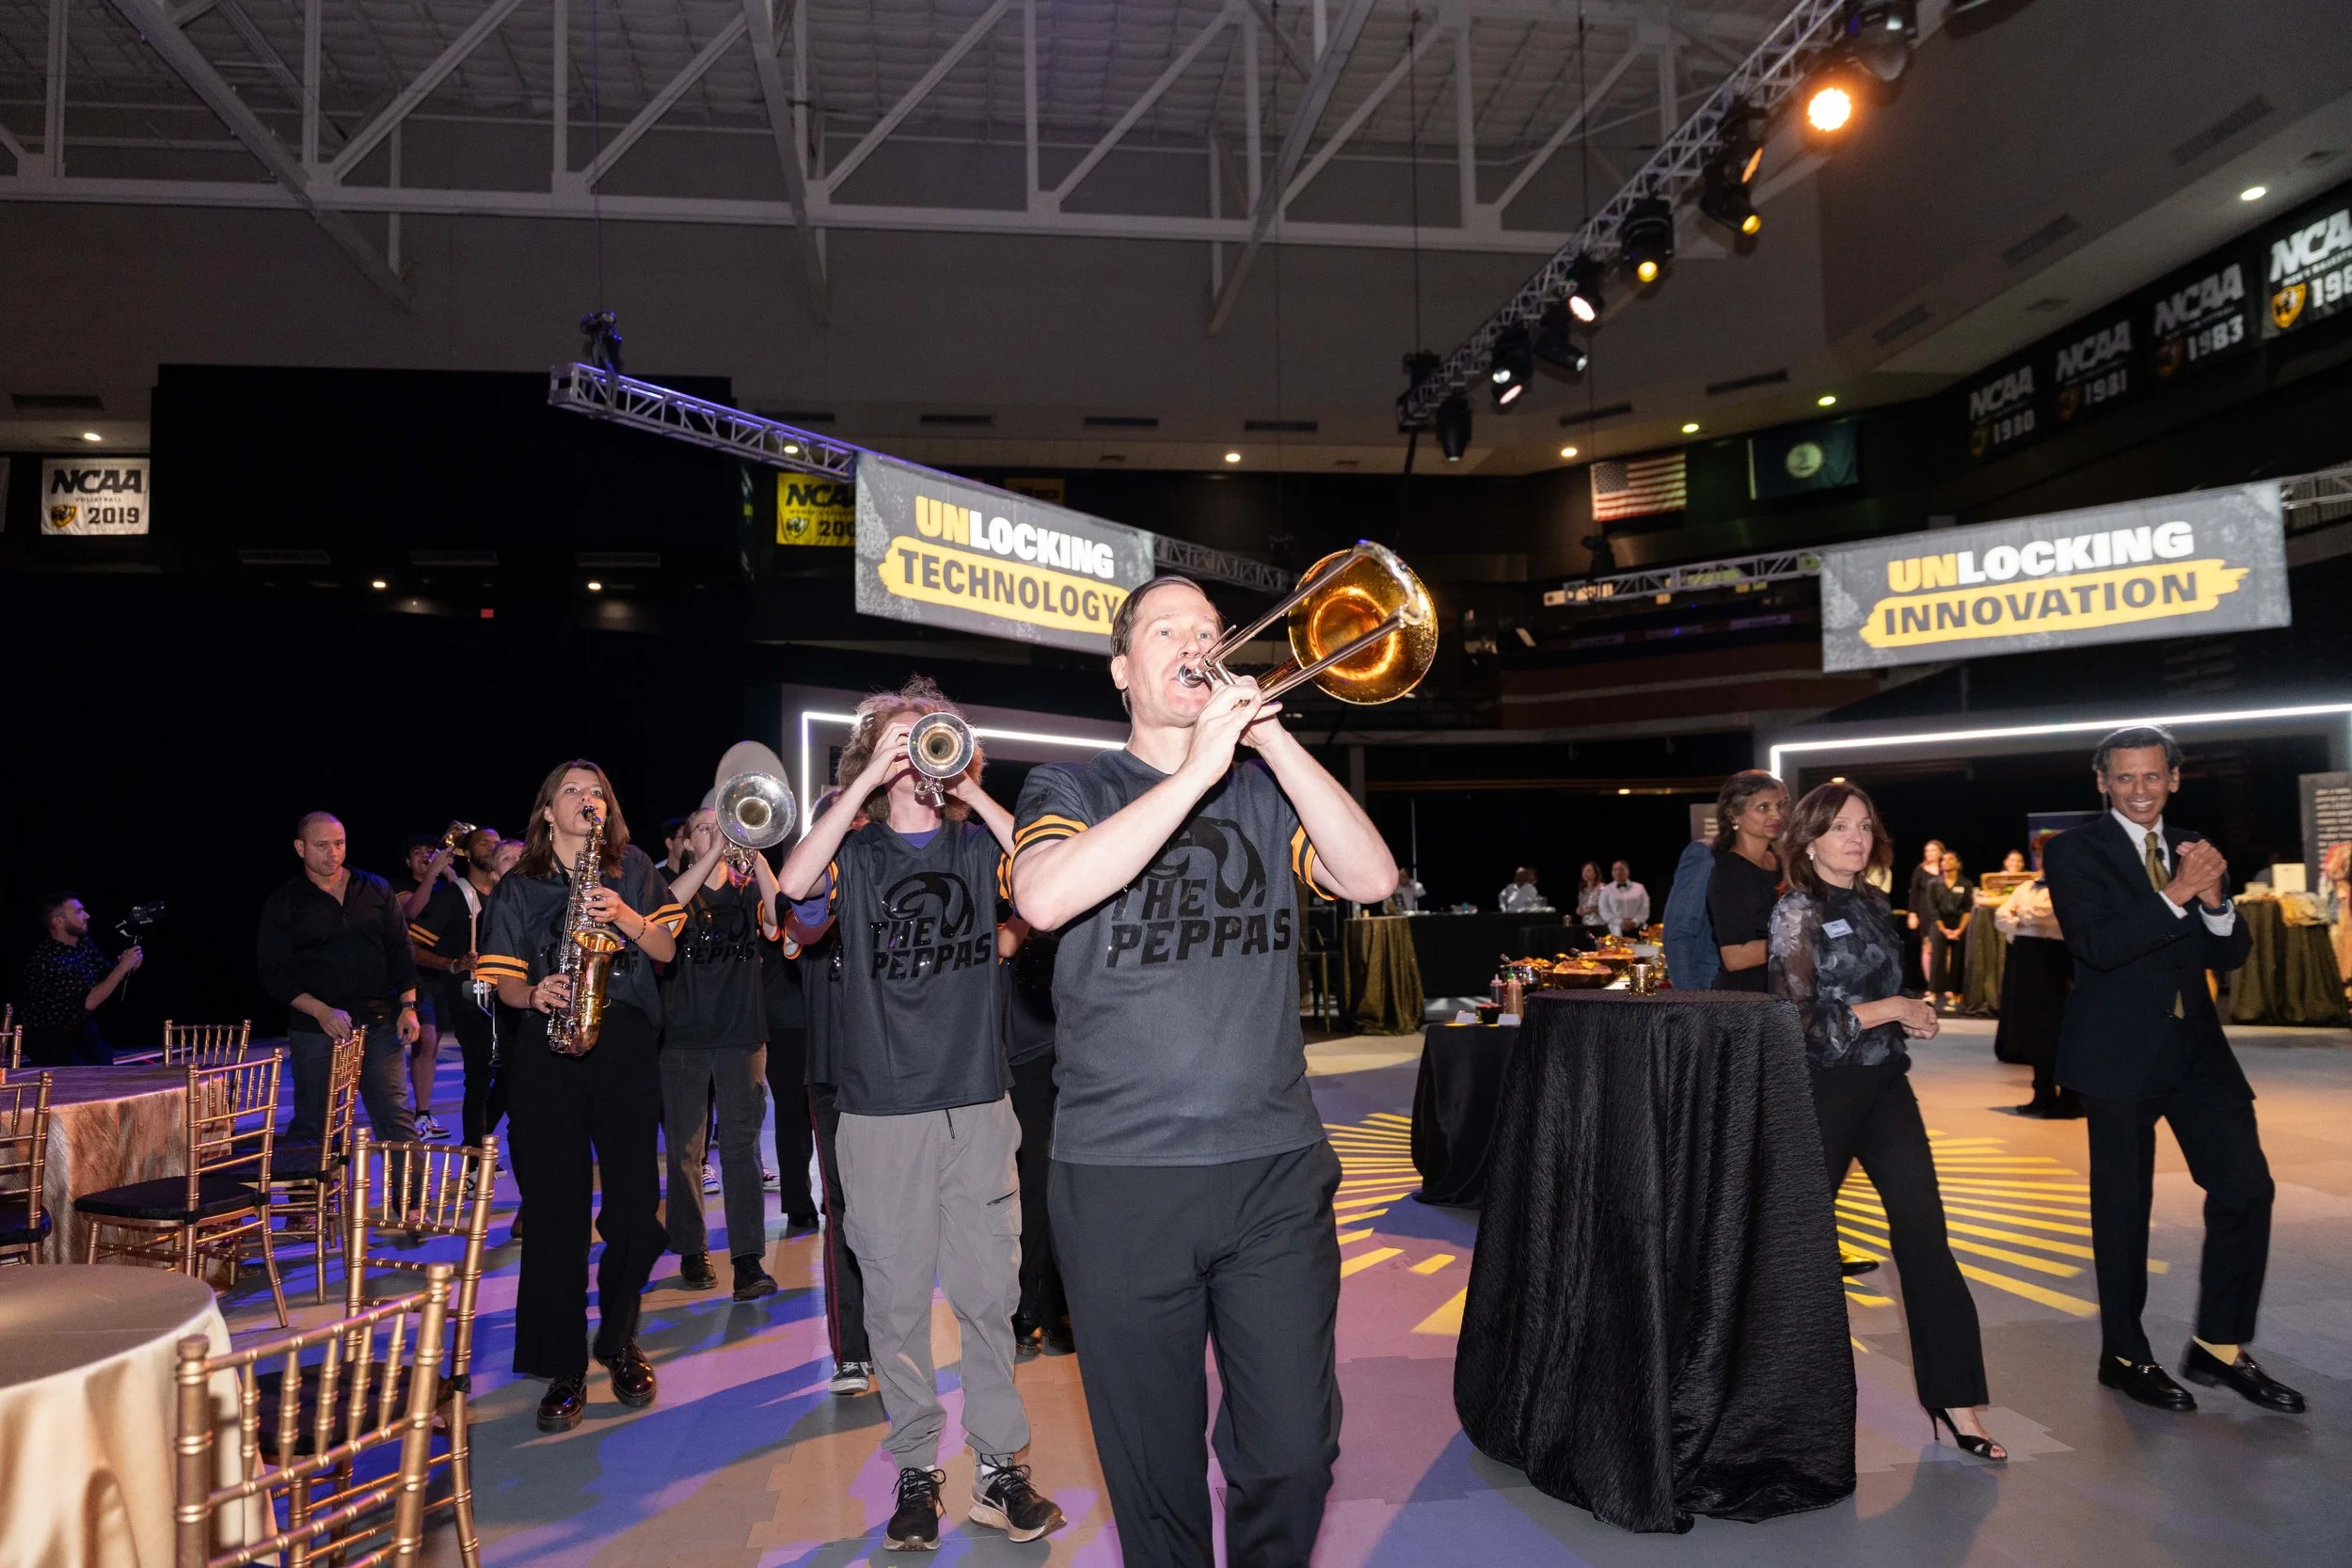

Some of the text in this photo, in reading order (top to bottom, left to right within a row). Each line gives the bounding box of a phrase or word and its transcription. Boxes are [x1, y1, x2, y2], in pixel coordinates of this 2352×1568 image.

[2269, 209, 2352, 282] NCA
[2154, 262, 2245, 337] NCAA
[2311, 263, 2352, 309] 198
[2056, 320, 2133, 382] NCAA
[2188, 314, 2244, 362] 1983
[1970, 364, 2034, 421] NCAA
[2085, 368, 2127, 406] 1981
[51, 469, 142, 494] NCAA
[786, 483, 856, 507] NCA
[88, 507, 140, 524] 2019
[819, 520, 856, 537] 200
[915, 495, 1115, 579] UNLOCKING
[1887, 520, 2195, 594] UNLOCKING
[898, 547, 1120, 625] TECHNOLOGY
[1884, 571, 2198, 637] INNOVATION
[869, 916, 936, 950] THE
[870, 933, 993, 981] PEPPAS
[1105, 908, 1291, 969] PEPPAS
